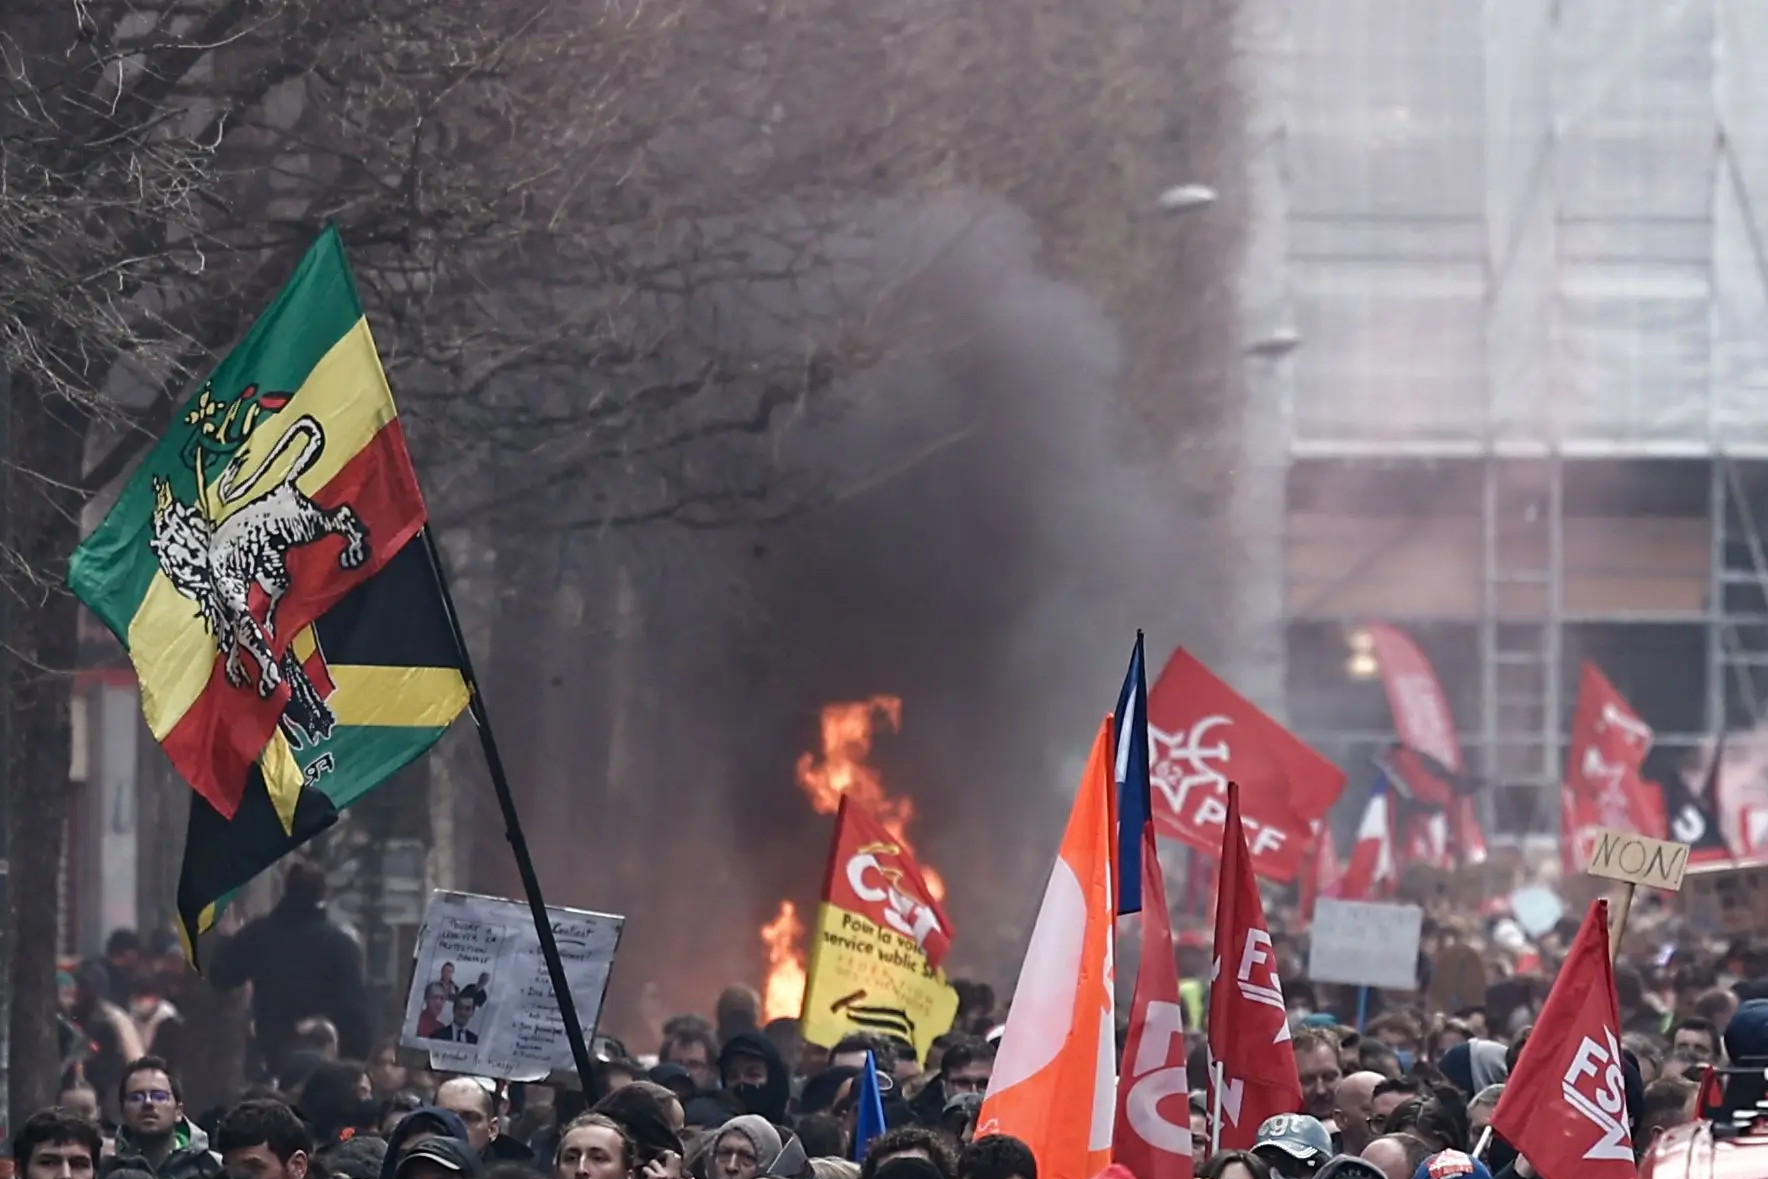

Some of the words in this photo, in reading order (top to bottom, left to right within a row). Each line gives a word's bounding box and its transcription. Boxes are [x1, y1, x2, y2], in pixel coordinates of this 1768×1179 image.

[841, 912, 875, 936] Pour
[878, 926, 892, 944] la
[824, 931, 874, 954] service
